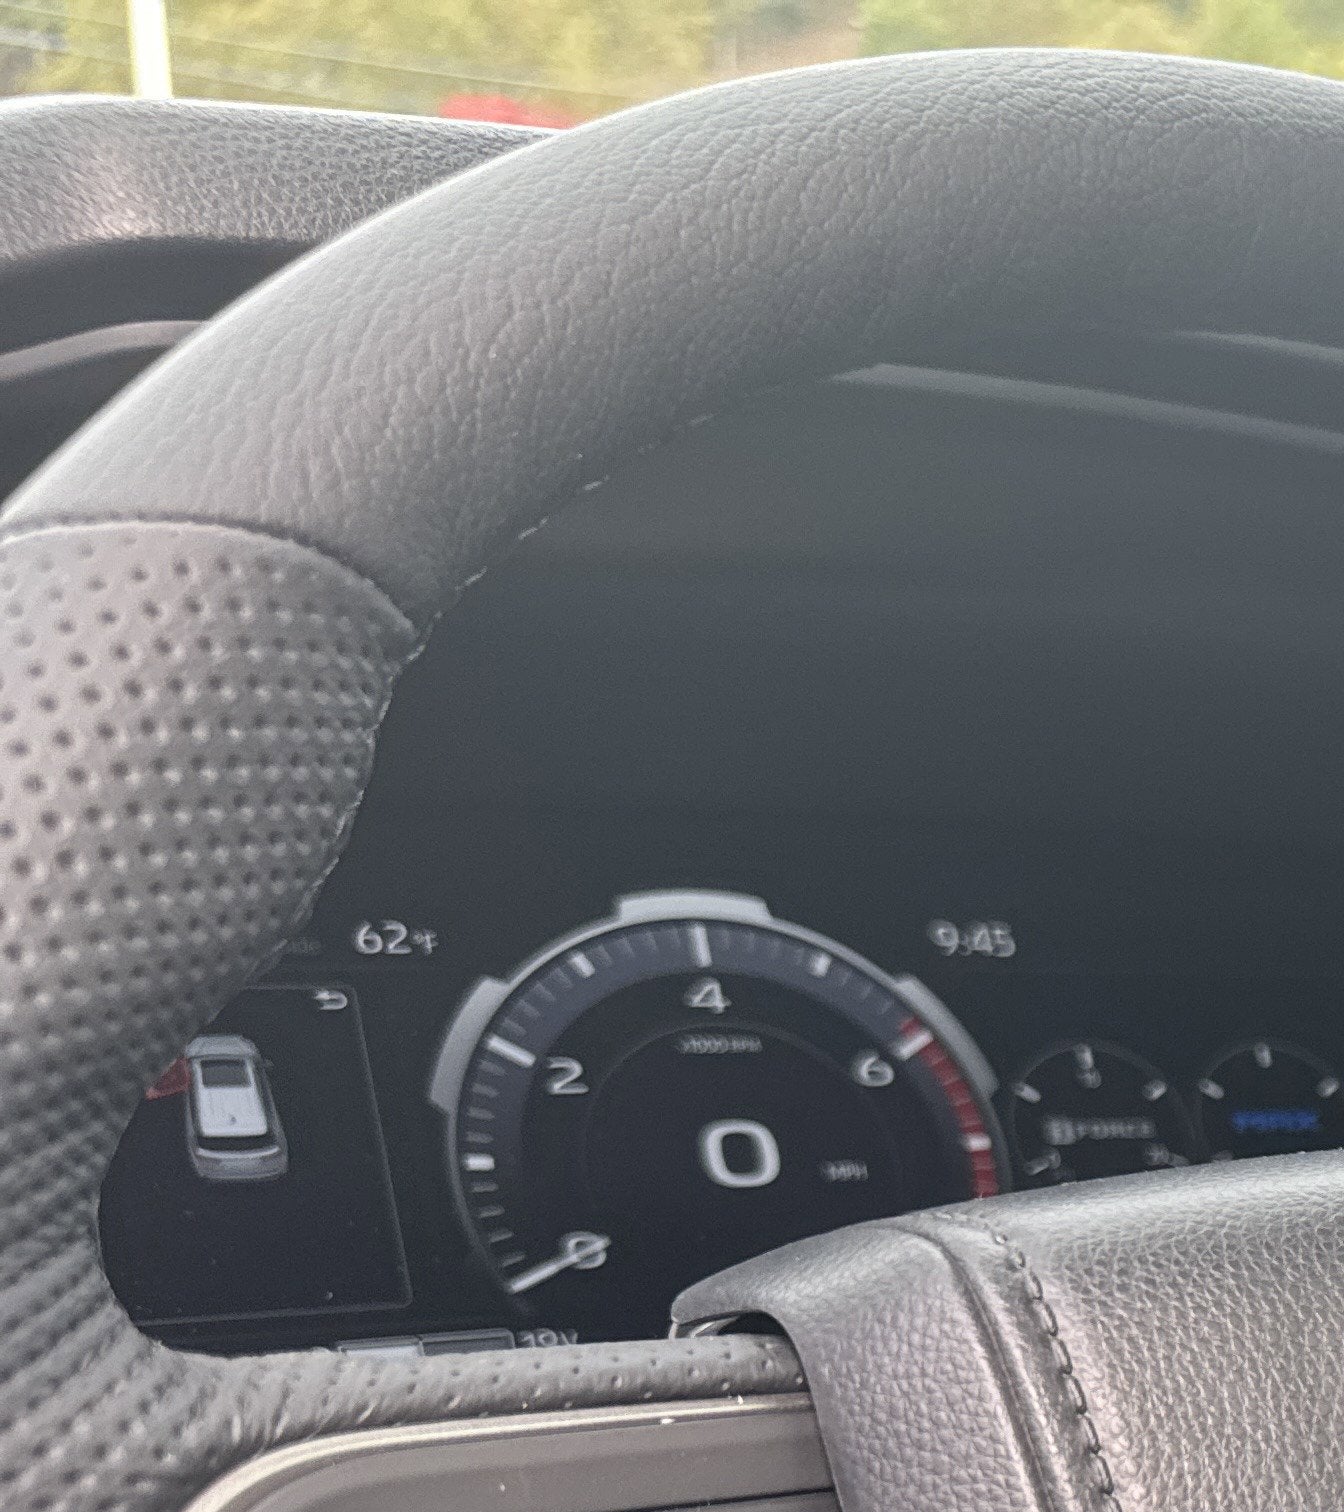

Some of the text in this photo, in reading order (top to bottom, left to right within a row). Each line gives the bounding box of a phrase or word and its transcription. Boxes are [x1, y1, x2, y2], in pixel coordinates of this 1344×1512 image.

[929, 920, 1016, 956] 9:45
[685, 979, 732, 1014] 4
[546, 1057, 589, 1094] 2
[853, 1052, 894, 1086] 6
[700, 1118, 781, 1187] 0
